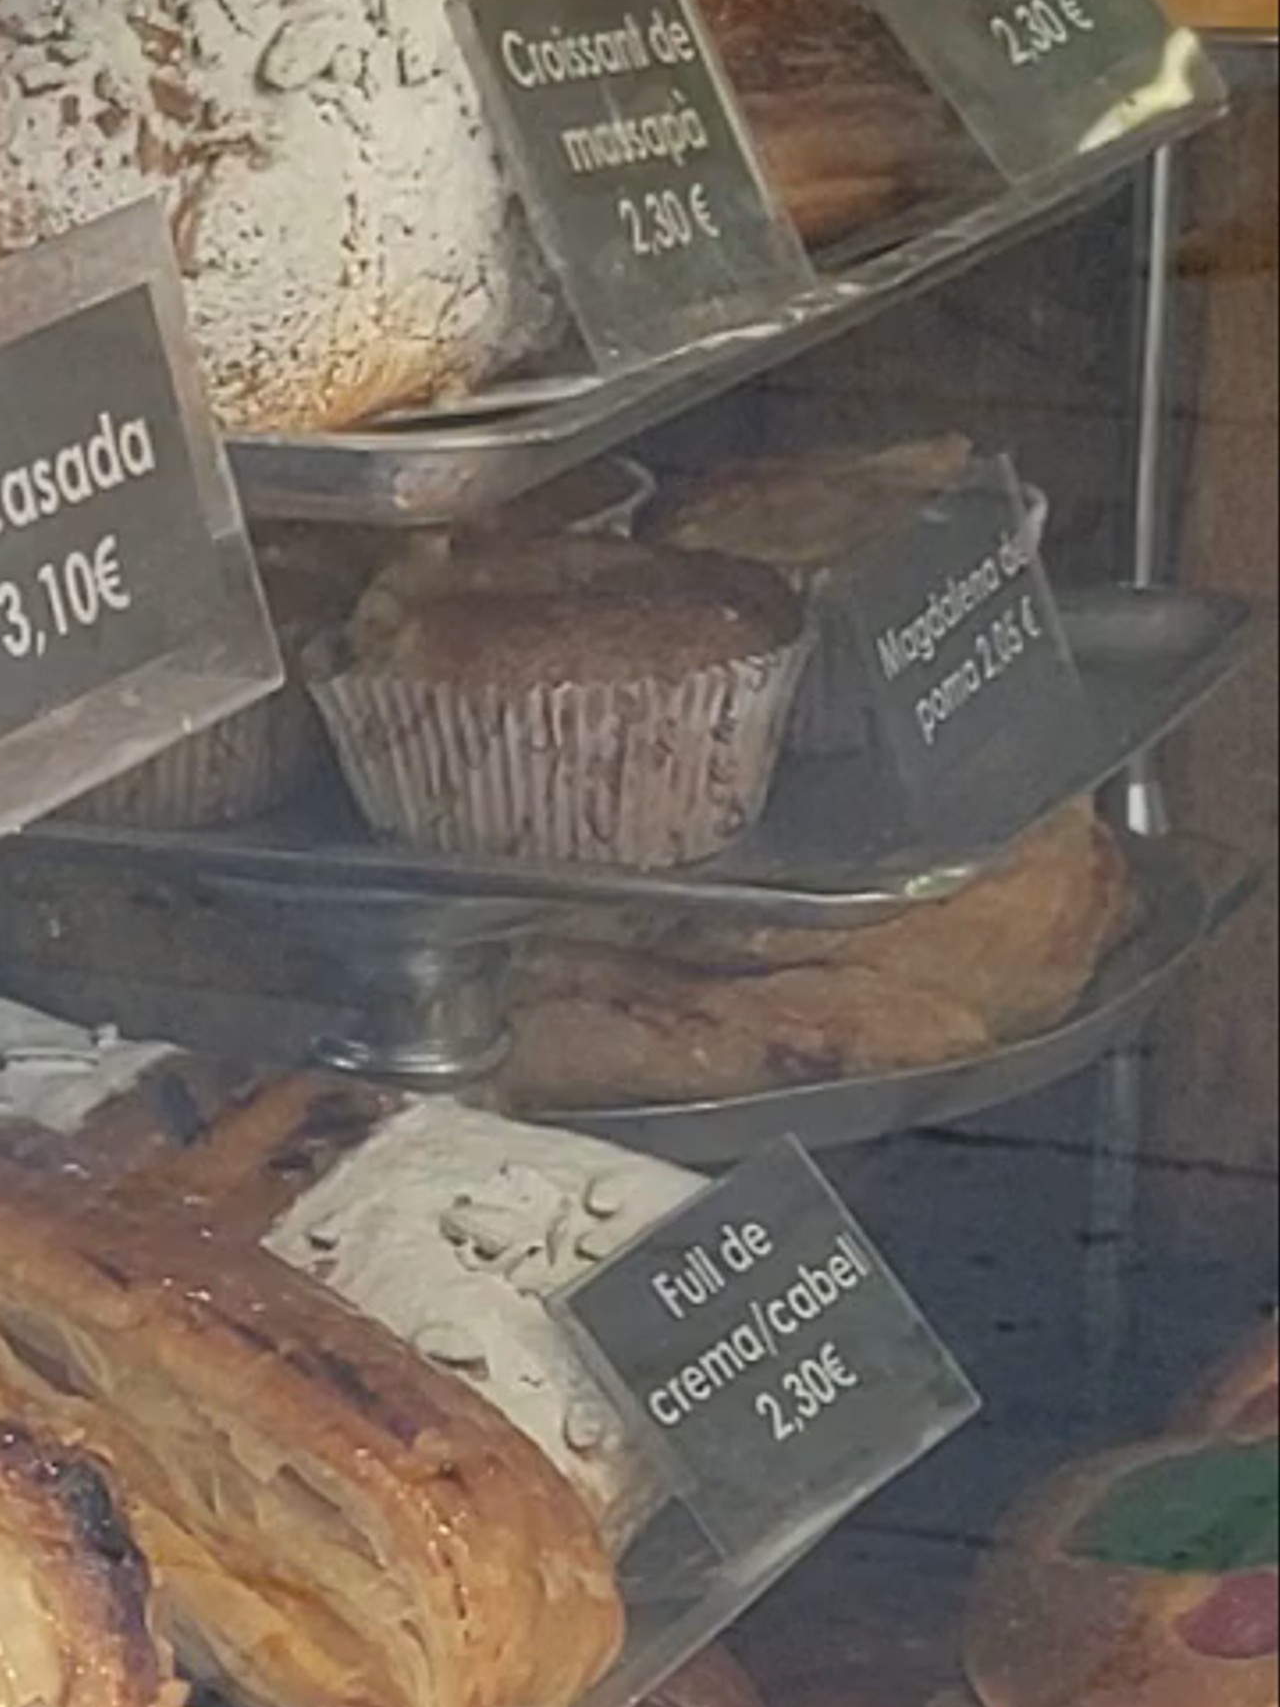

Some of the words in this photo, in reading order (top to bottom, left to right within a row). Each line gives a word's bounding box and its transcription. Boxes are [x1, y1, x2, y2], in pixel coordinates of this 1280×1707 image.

[503, 12, 650, 88] Croissant
[649, 7, 694, 64] de
[561, 89, 708, 171] massapà
[619, 189, 693, 255] 2,30
[690, 183, 720, 237] €
[916, 659, 981, 745] poma
[652, 1245, 726, 1319] Full
[720, 1222, 773, 1272] de
[755, 1342, 858, 1441] 2,30€
